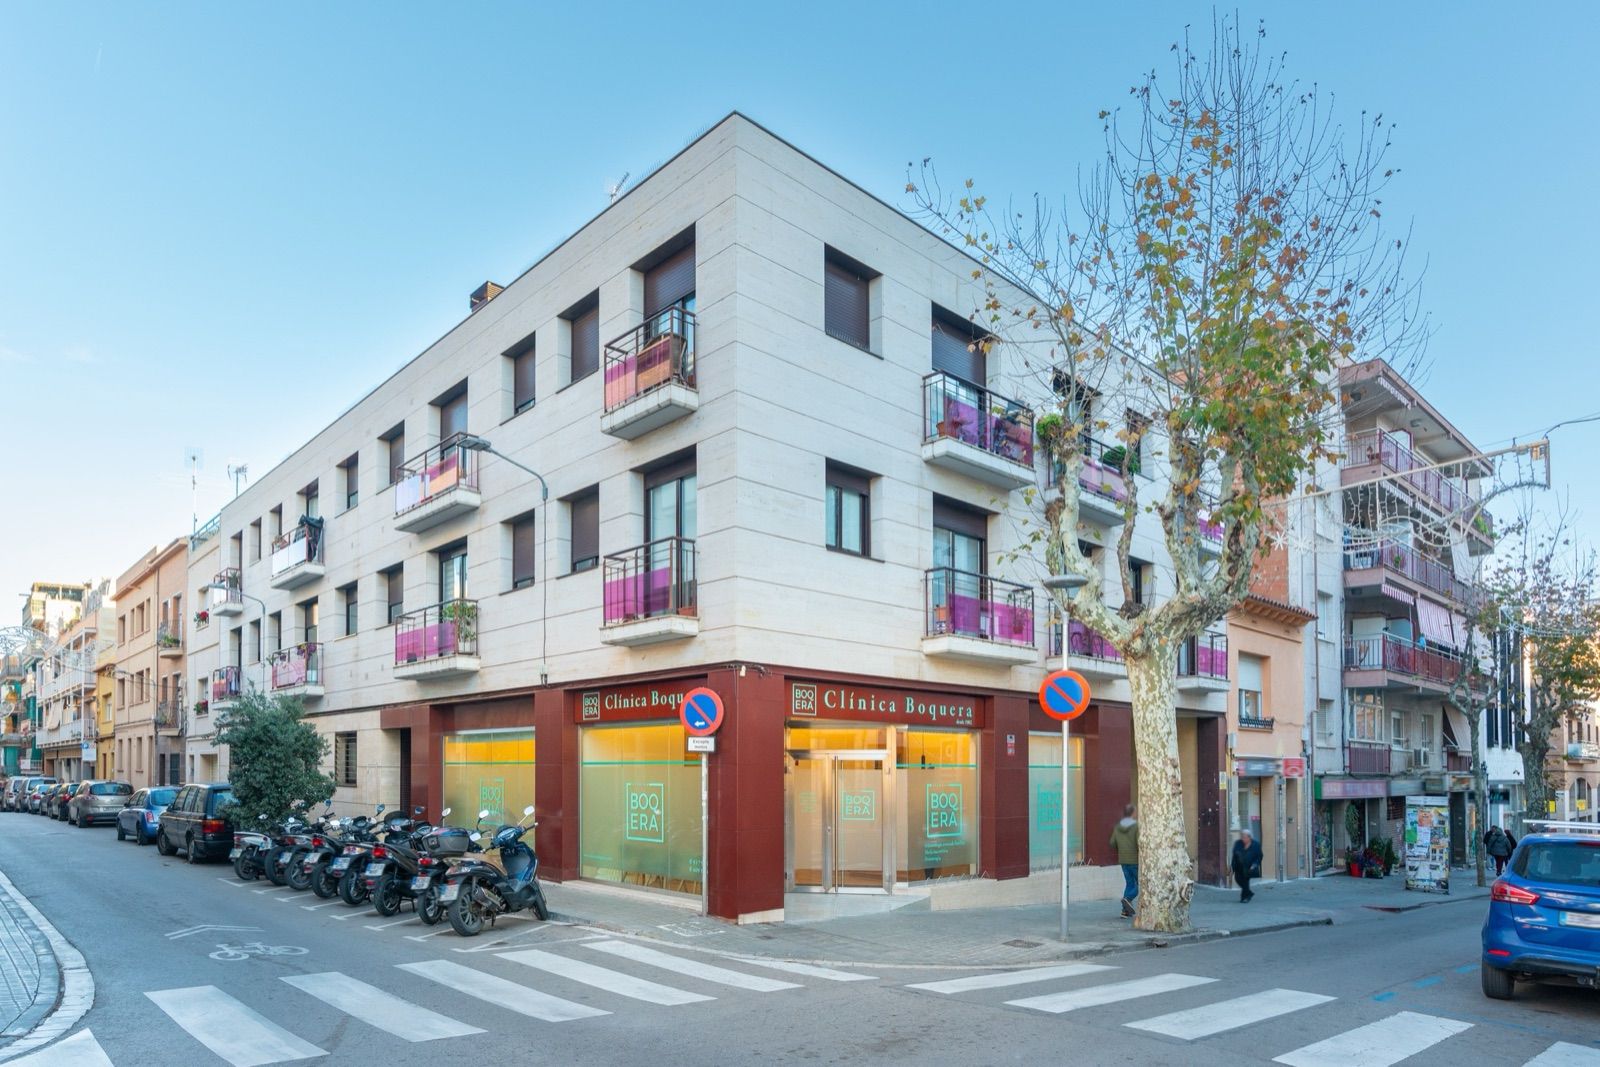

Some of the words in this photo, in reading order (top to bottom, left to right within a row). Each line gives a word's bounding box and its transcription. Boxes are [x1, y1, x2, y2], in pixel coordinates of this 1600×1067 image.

[584, 697, 598, 706] BOQ
[605, 693, 647, 710] Clínica
[651, 690, 684, 710] Boqu
[795, 688, 814, 701] BOQ
[584, 706, 598, 716] ERA
[796, 700, 814, 710] ERA
[824, 689, 896, 713] Clínica
[905, 696, 973, 721] Boquera
[630, 792, 660, 812] BOQ
[846, 794, 871, 806] BOQ
[930, 792, 958, 812] BOQ
[846, 805, 871, 816] ERA
[630, 813, 659, 832] ERA
[930, 811, 958, 828] ERA
